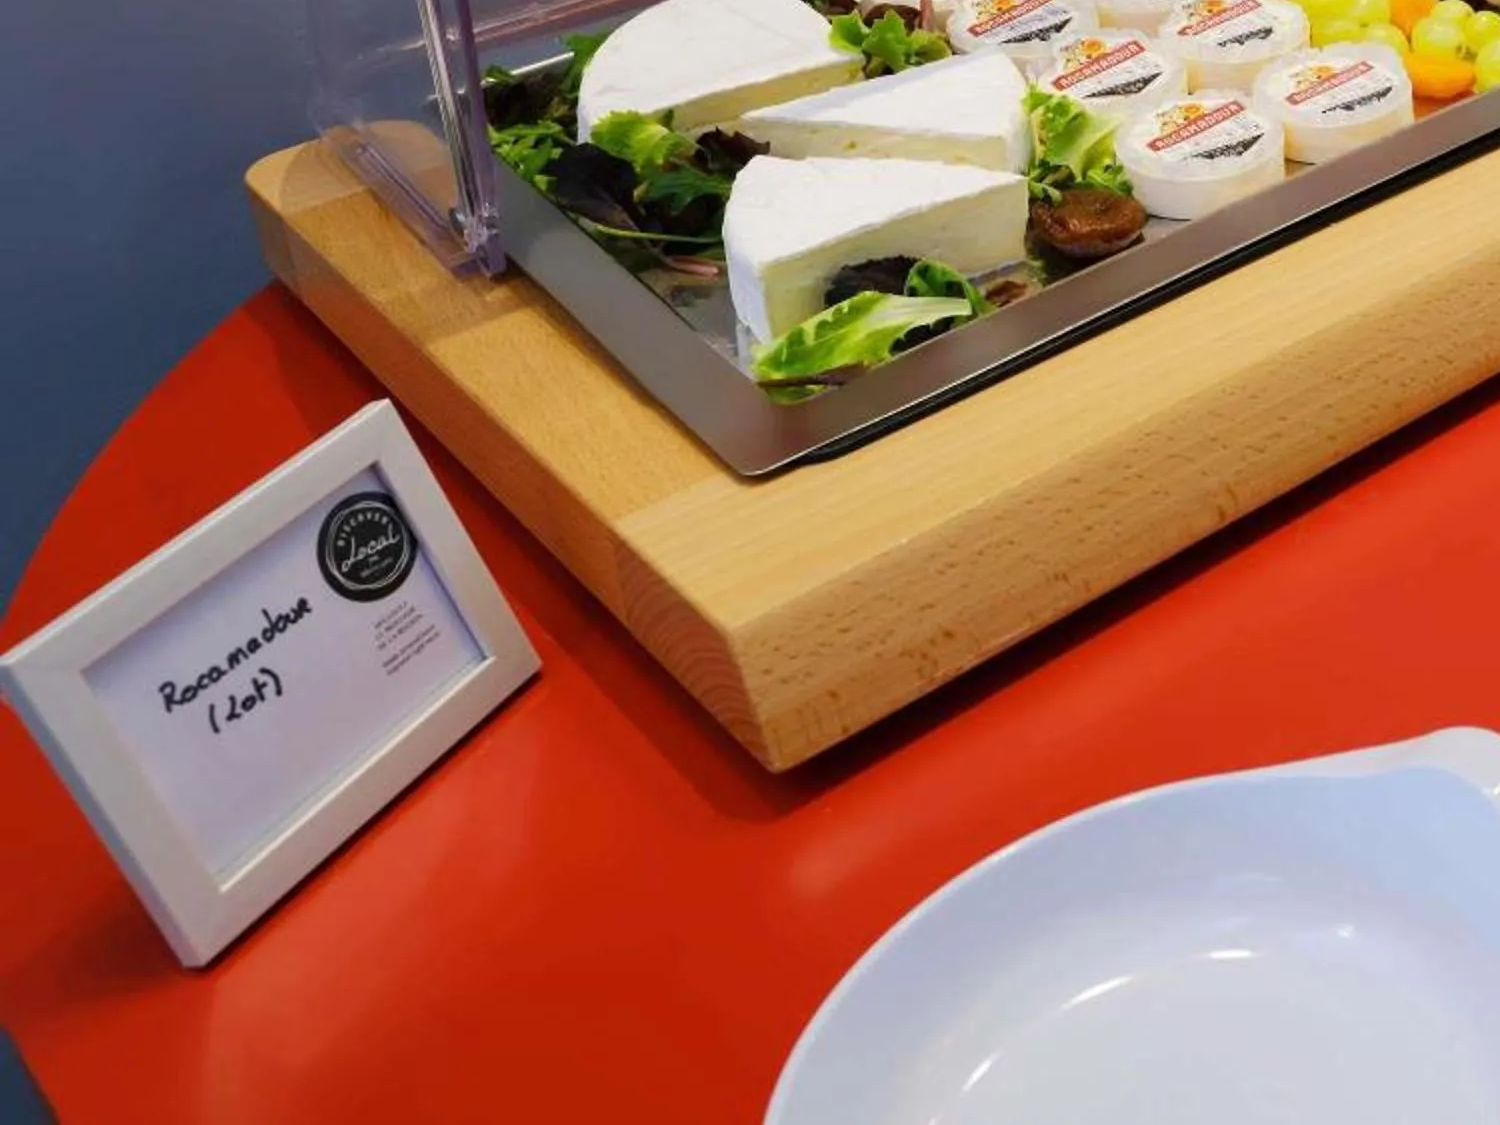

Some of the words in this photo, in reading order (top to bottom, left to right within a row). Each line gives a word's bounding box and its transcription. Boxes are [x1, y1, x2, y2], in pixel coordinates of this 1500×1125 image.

[1058, 41, 1141, 87] ROCAMADOUR
[1153, 102, 1240, 148] ROCAMADOUR
[340, 522, 400, 573] Local
[158, 596, 312, 714] Rocamadour
[207, 666, 283, 735] (Lot)
